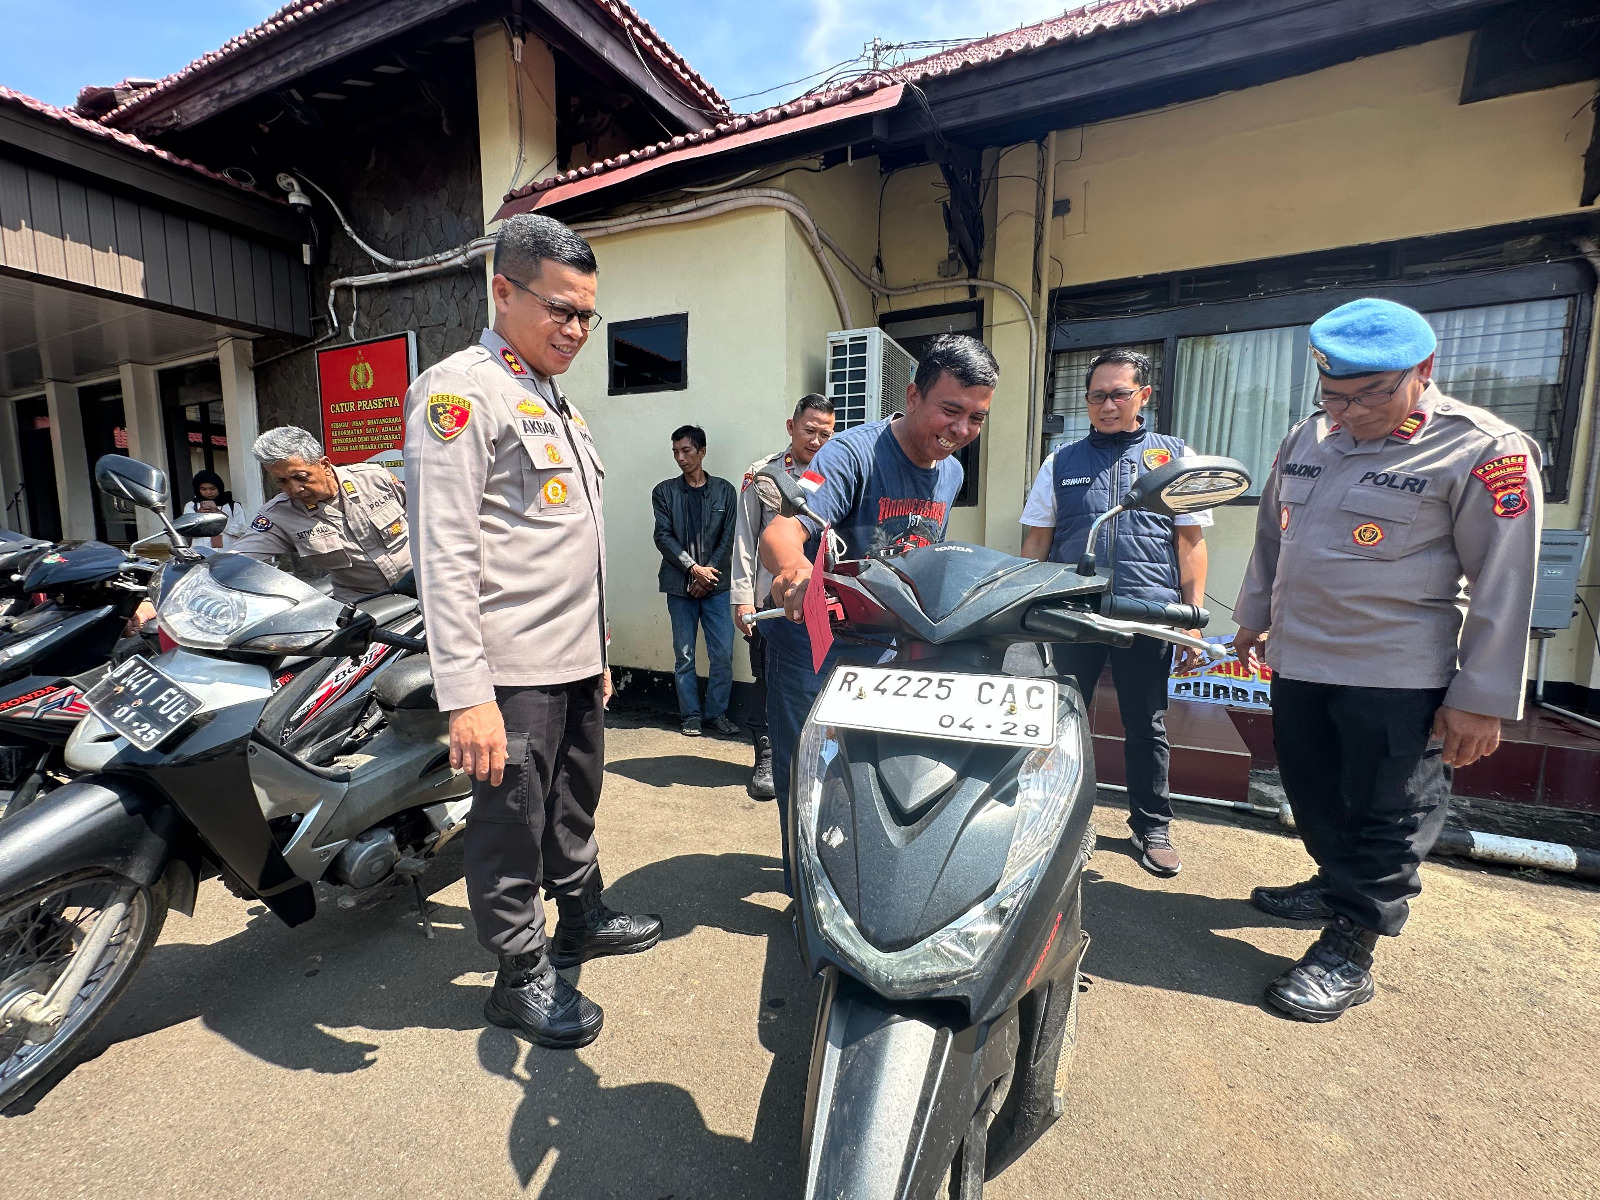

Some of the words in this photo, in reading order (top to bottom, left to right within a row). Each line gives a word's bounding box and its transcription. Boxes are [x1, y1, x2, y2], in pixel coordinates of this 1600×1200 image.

[330, 401, 356, 414] CATUR
[357, 396, 400, 411] PRASETYA
[430, 395, 471, 410] RESERSE
[522, 419, 558, 436] AKBAR
[1475, 456, 1524, 475] POLRES
[1062, 477, 1091, 486] SISWANTO
[1359, 471, 1427, 494] POLRI
[297, 529, 314, 540] SETYO
[316, 526, 331, 535] HADI
[0, 685, 60, 711] HONDA
[838, 671, 858, 692] R
[873, 673, 956, 700] 4225
[976, 681, 1046, 710] CAC
[148, 687, 190, 723] FUE
